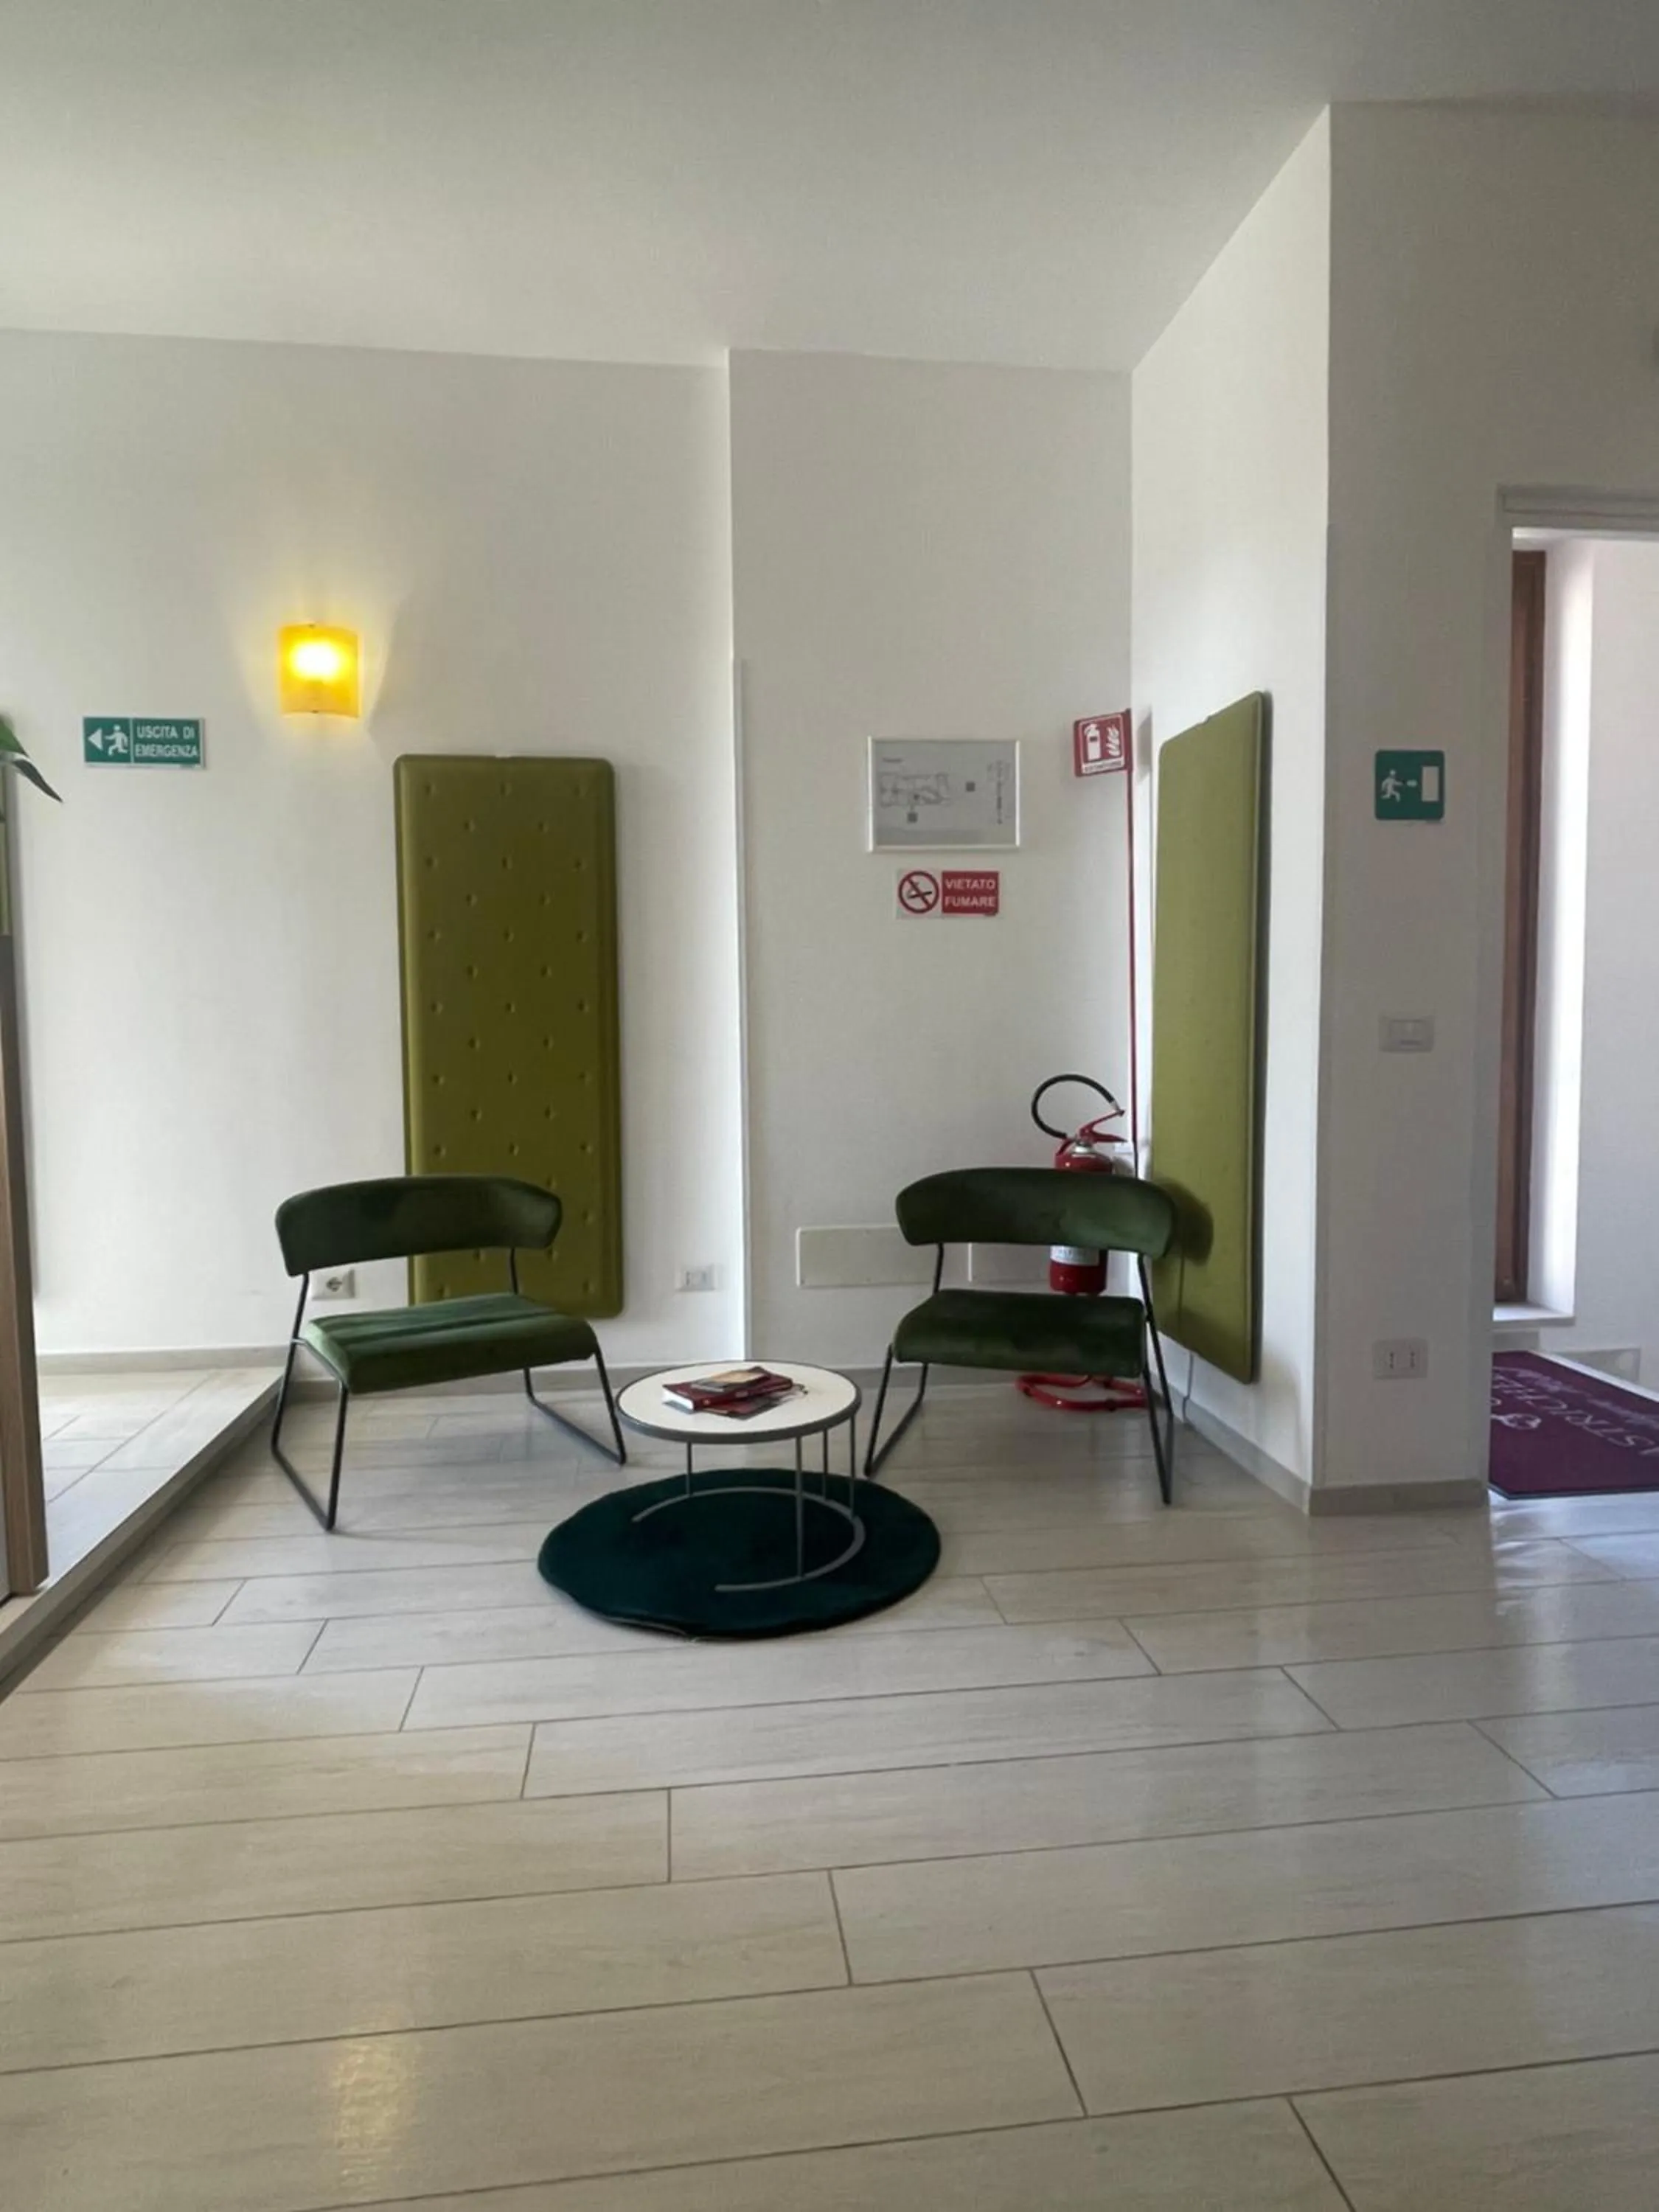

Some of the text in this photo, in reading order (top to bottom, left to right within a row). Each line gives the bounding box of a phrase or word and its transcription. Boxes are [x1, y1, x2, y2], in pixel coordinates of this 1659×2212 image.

[136, 725, 195, 739] USCITA DI
[135, 744, 198, 757] EMERGENZA
[945, 878, 995, 890] VIETATO
[945, 895, 995, 908] FUMARE
